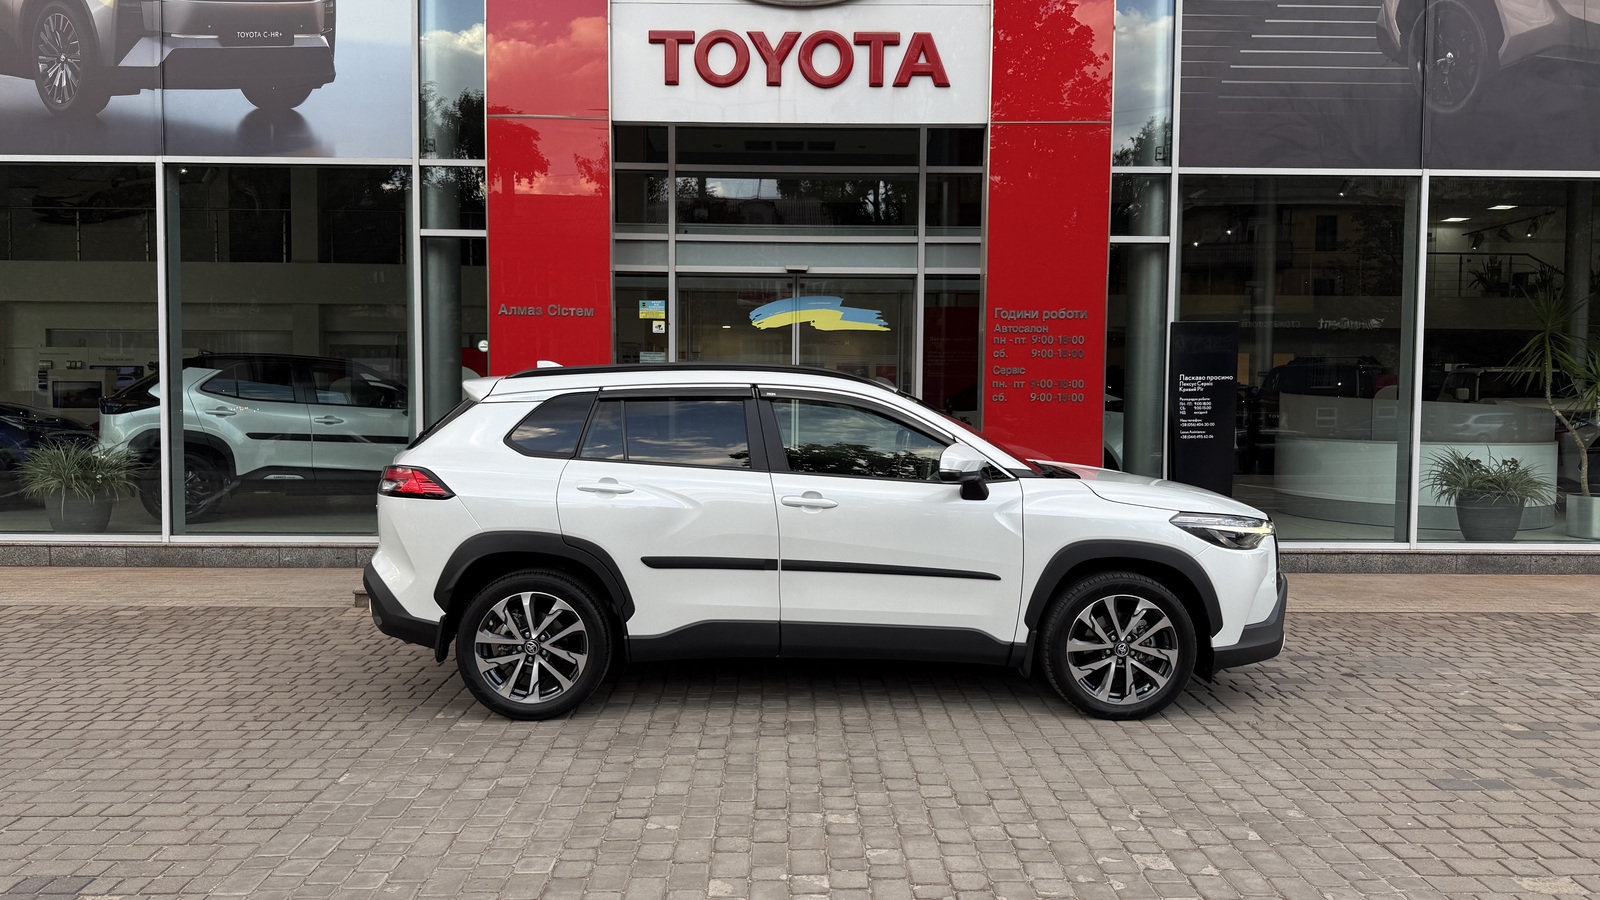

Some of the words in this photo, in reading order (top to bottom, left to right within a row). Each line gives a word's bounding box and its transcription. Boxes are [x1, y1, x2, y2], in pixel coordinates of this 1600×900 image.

[648, 29, 951, 88] TOYOTA
[498, 303, 543, 316] Алмаз
[547, 304, 595, 317] Сістем
[994, 308, 1039, 320] Години
[1042, 308, 1088, 321] роботи
[993, 324, 1049, 333] Автосалон
[993, 336, 1006, 344] пн
[992, 348, 1008, 358] сб.
[992, 365, 1026, 376] Сервіс
[992, 392, 1008, 402] сб.
